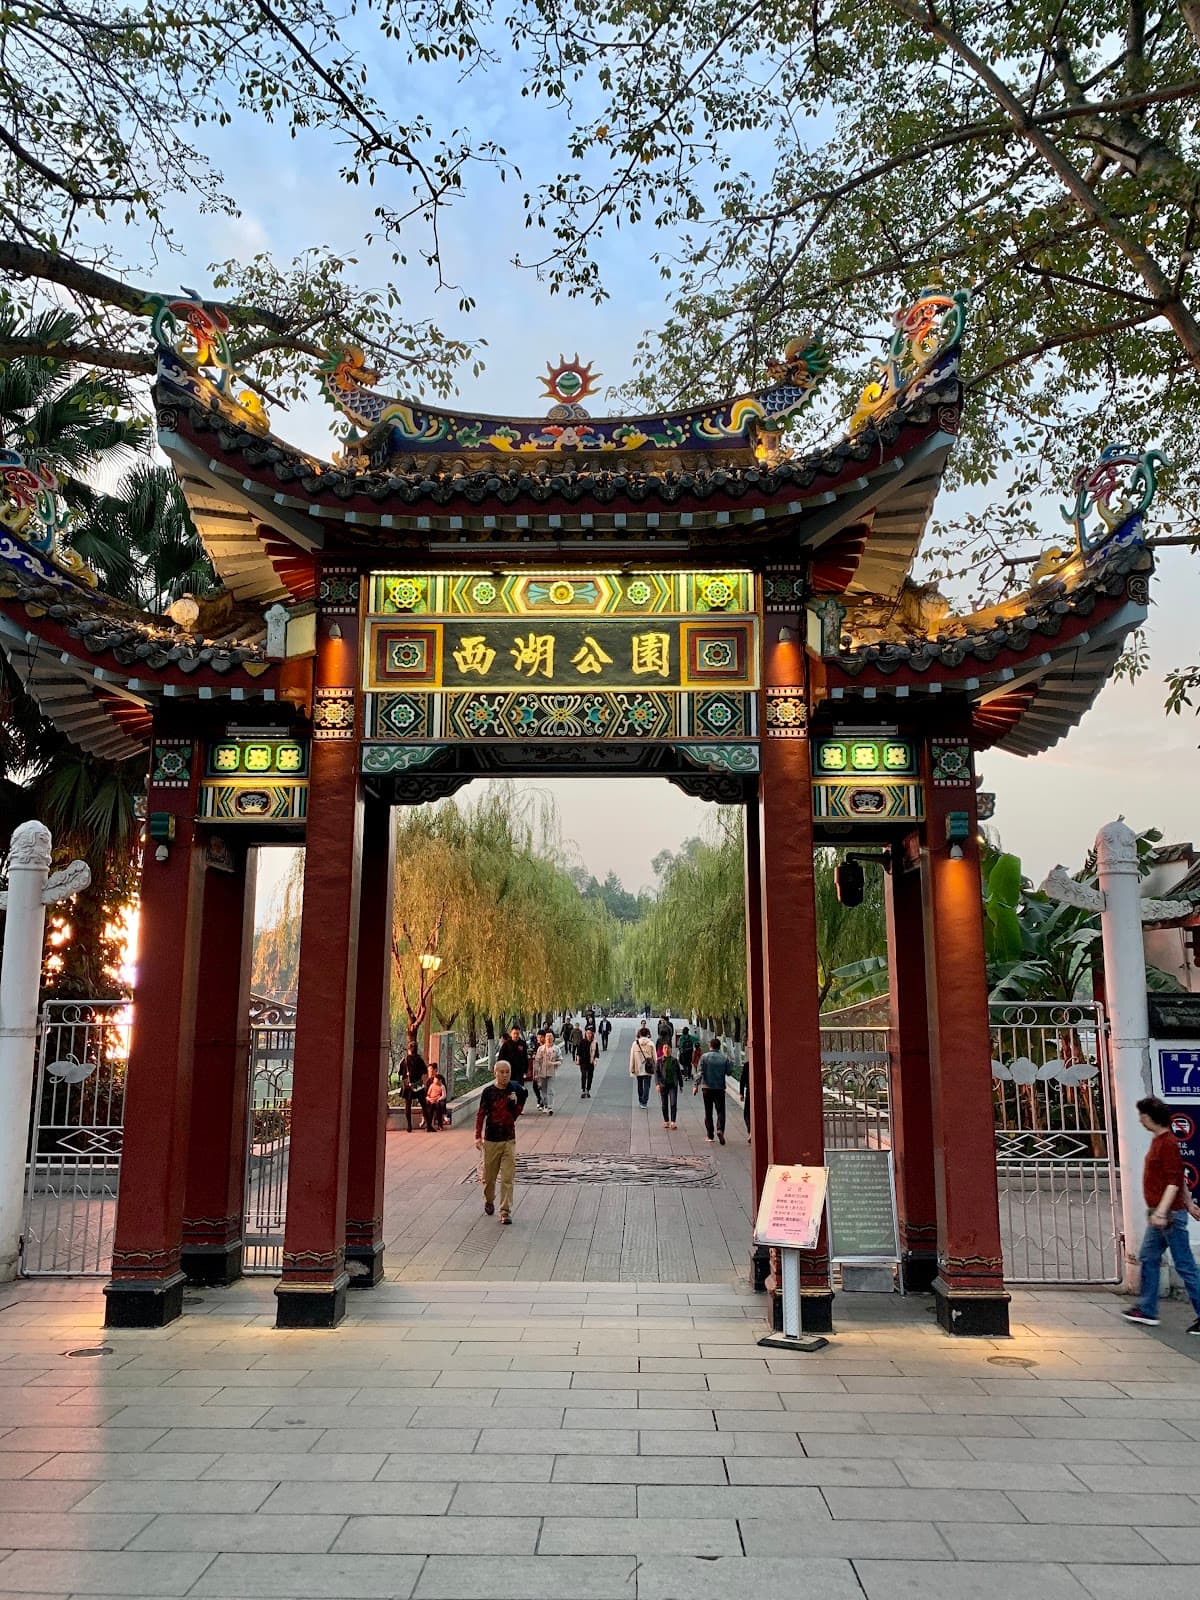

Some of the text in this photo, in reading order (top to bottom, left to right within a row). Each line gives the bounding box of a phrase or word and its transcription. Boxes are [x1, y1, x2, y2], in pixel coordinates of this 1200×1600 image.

[452, 632, 671, 678] 西湖公園
[1179, 1063, 1200, 1084] 7
